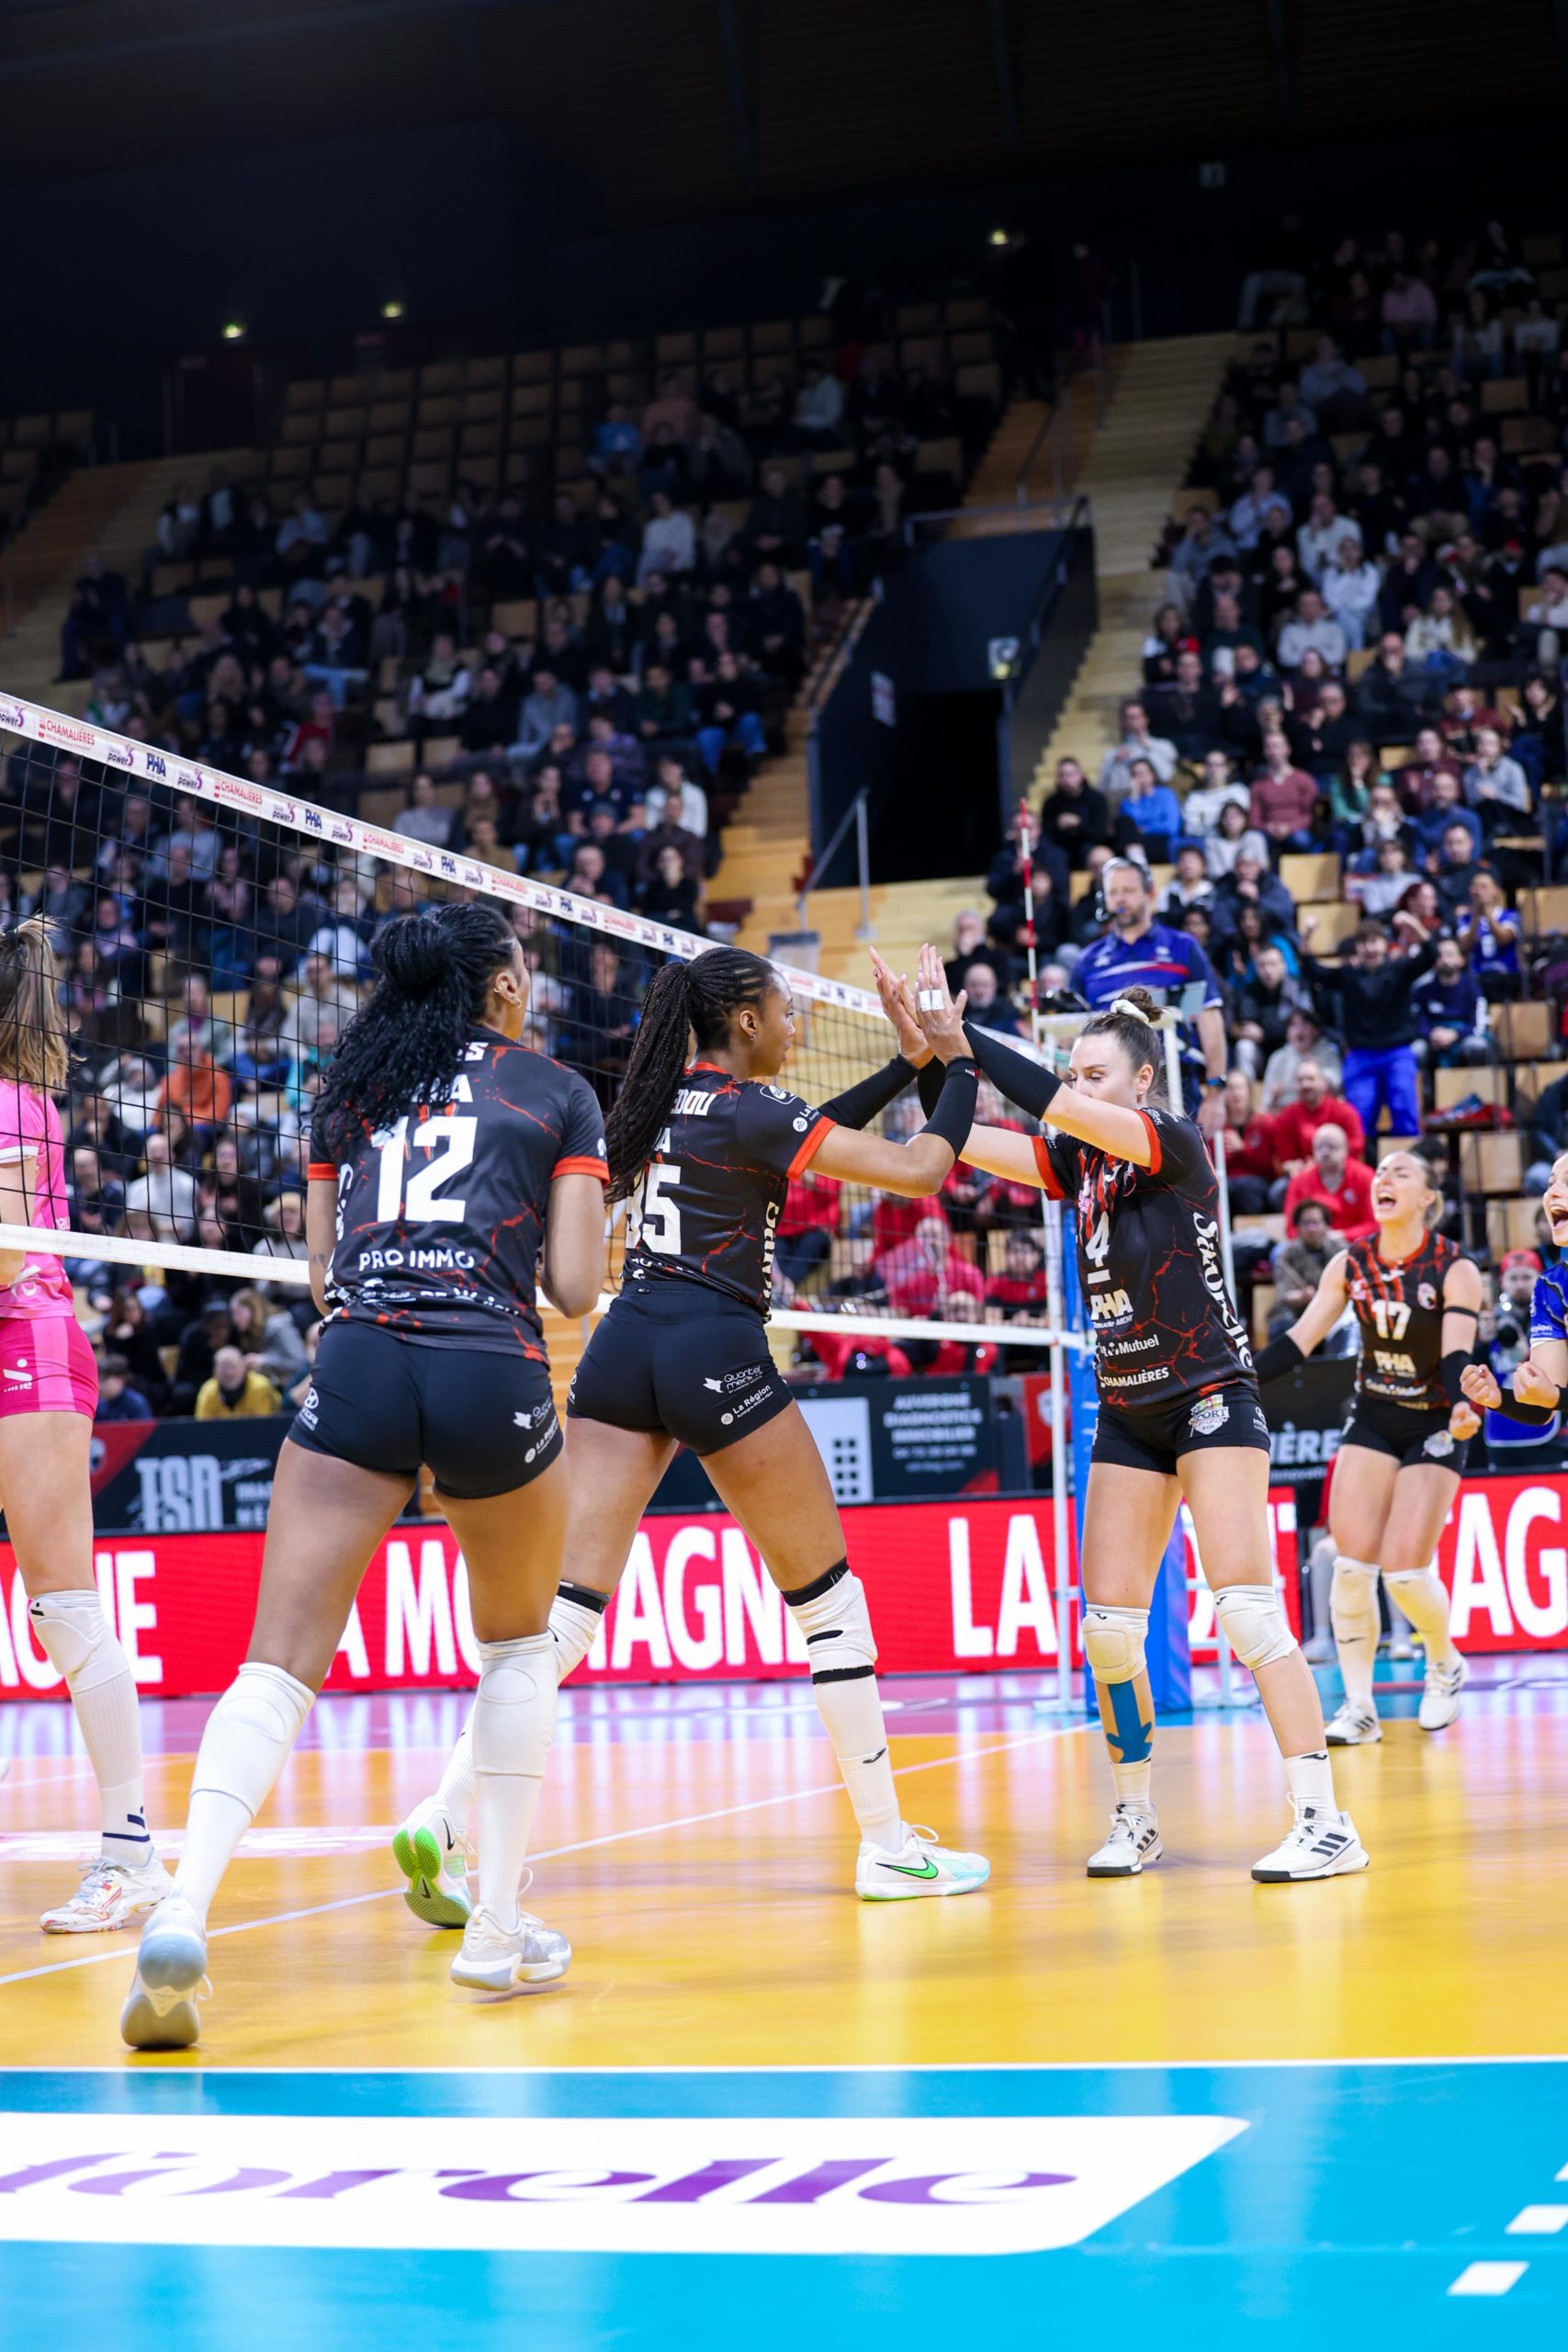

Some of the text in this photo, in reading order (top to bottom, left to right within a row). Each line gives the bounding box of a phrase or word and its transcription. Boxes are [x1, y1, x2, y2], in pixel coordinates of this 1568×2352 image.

[107, 752, 128, 765] power
[146, 752, 166, 776] PHA
[305, 808, 322, 830] PHA
[671, 1088, 717, 1115] DOU
[371, 1115, 478, 1223] 12
[1085, 1212, 1111, 1268] 4
[359, 1250, 475, 1271] PRO IMMO
[1090, 1288, 1134, 1320] PHA
[1193, 1212, 1253, 1369] Saorelle
[1371, 1299, 1412, 1340] 17
[1118, 1334, 1159, 1354] Mutuel
[1104, 1367, 1169, 1387] CHAMALIÈRES
[732, 1385, 771, 1414] La Région
[1430, 1487, 1568, 1638] AG
[949, 1514, 1059, 1657] LA
